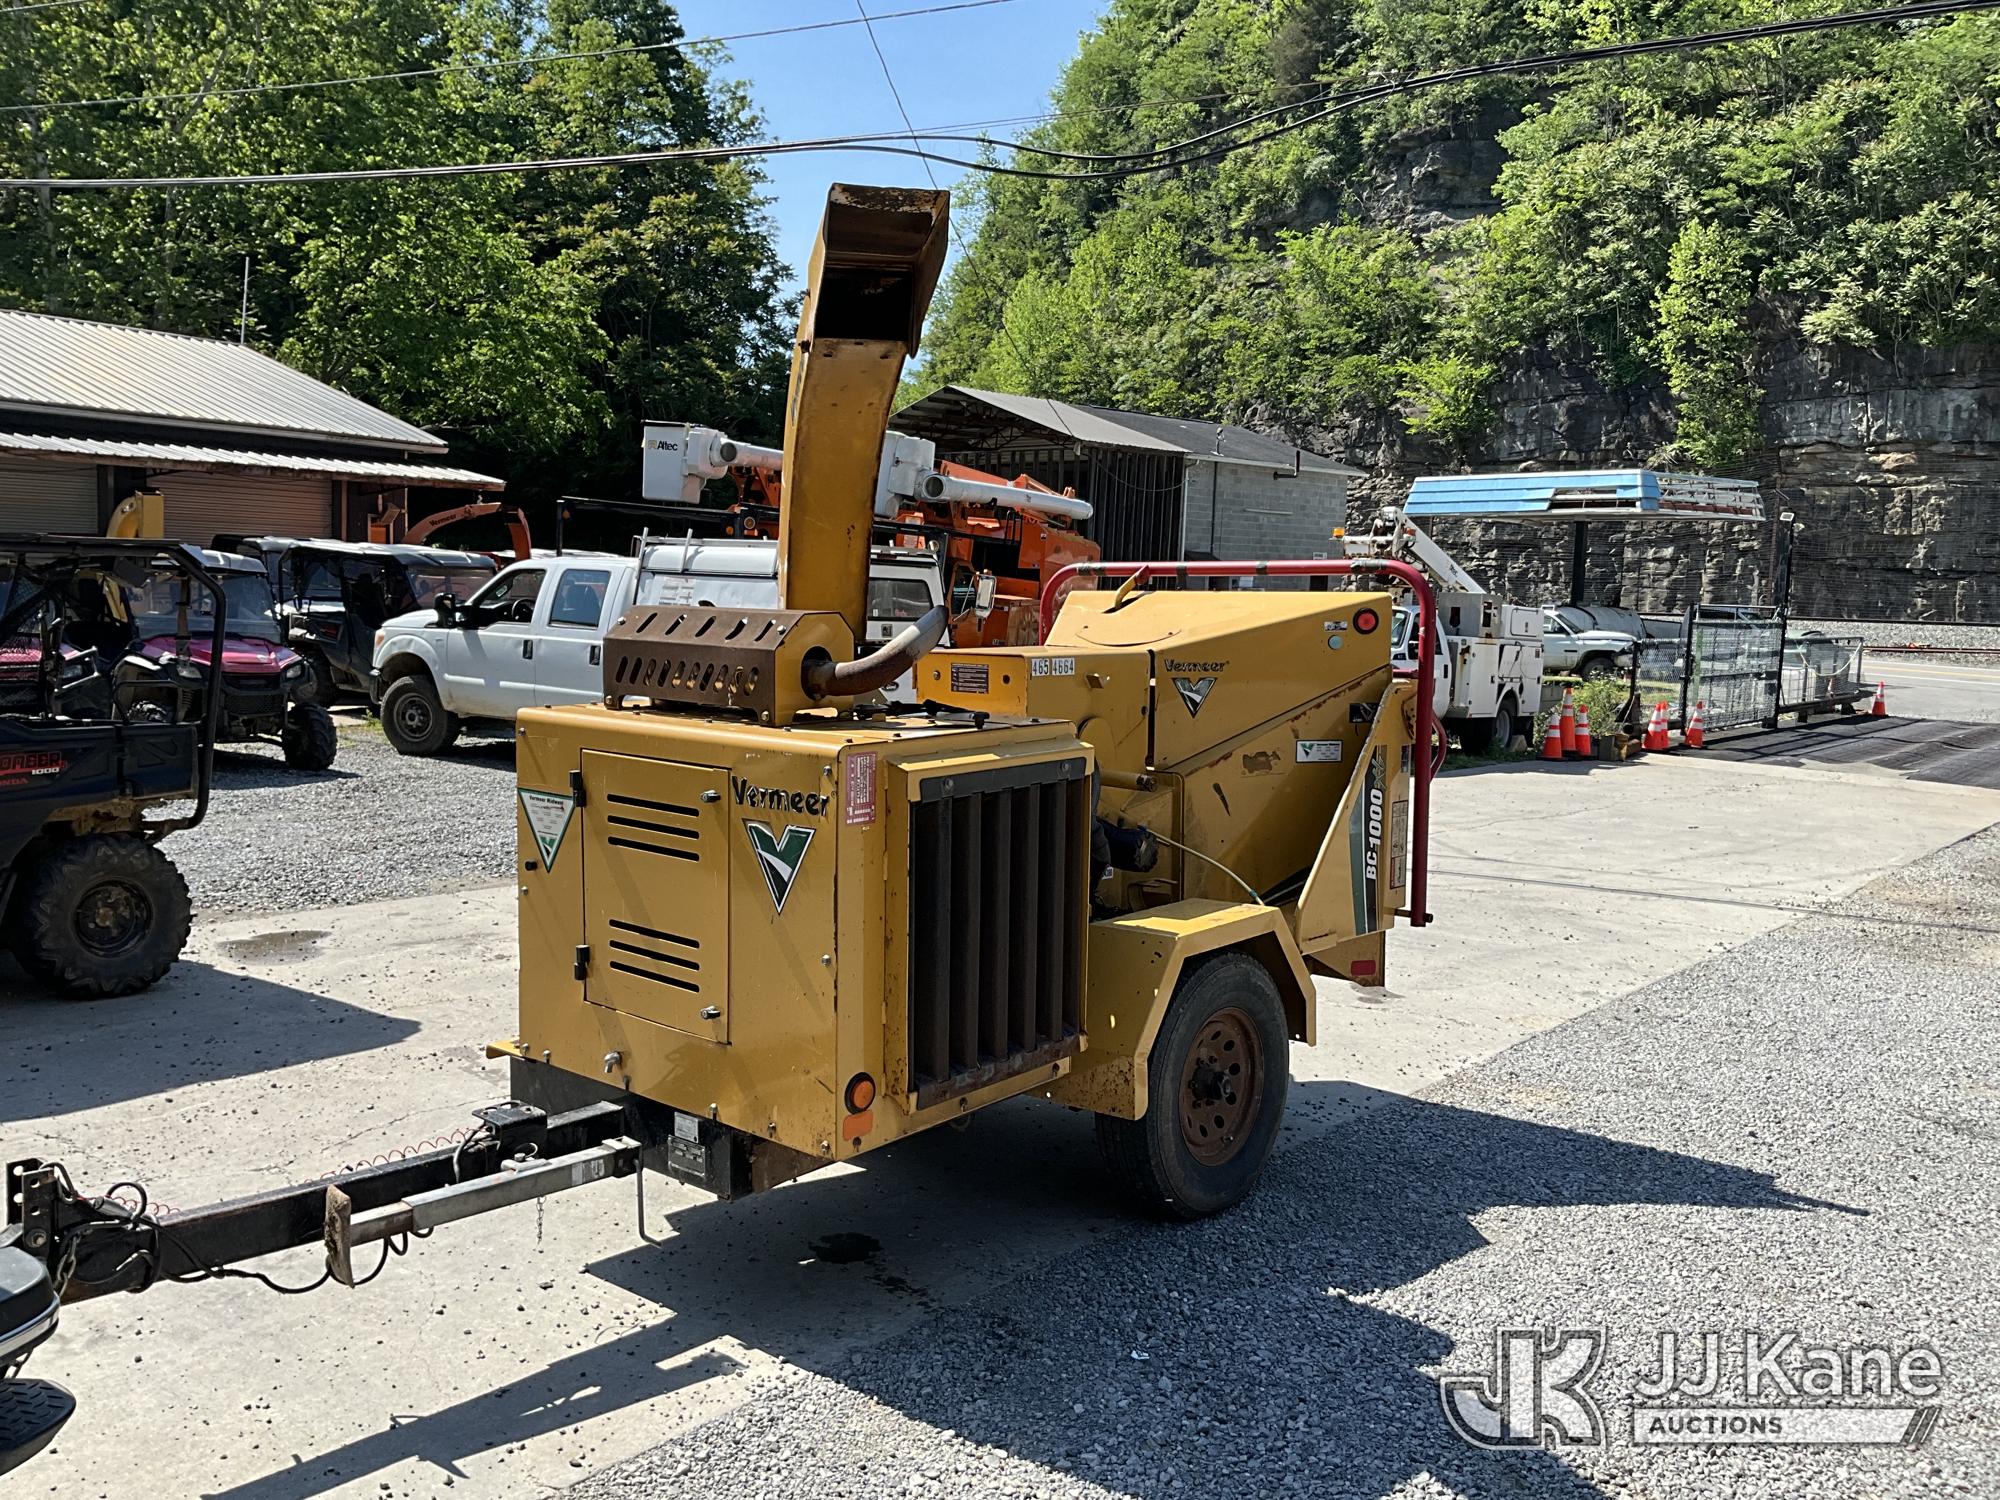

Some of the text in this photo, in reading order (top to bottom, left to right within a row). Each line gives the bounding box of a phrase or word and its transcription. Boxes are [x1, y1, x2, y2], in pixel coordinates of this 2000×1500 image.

[657, 441, 678, 451] Altec
[1032, 658, 1074, 675] 465 4664
[1164, 659, 1225, 672] Vermeer
[31, 767, 60, 775] 1000
[732, 776, 830, 816] Vermeer
[1366, 788, 1383, 879] BC1000
